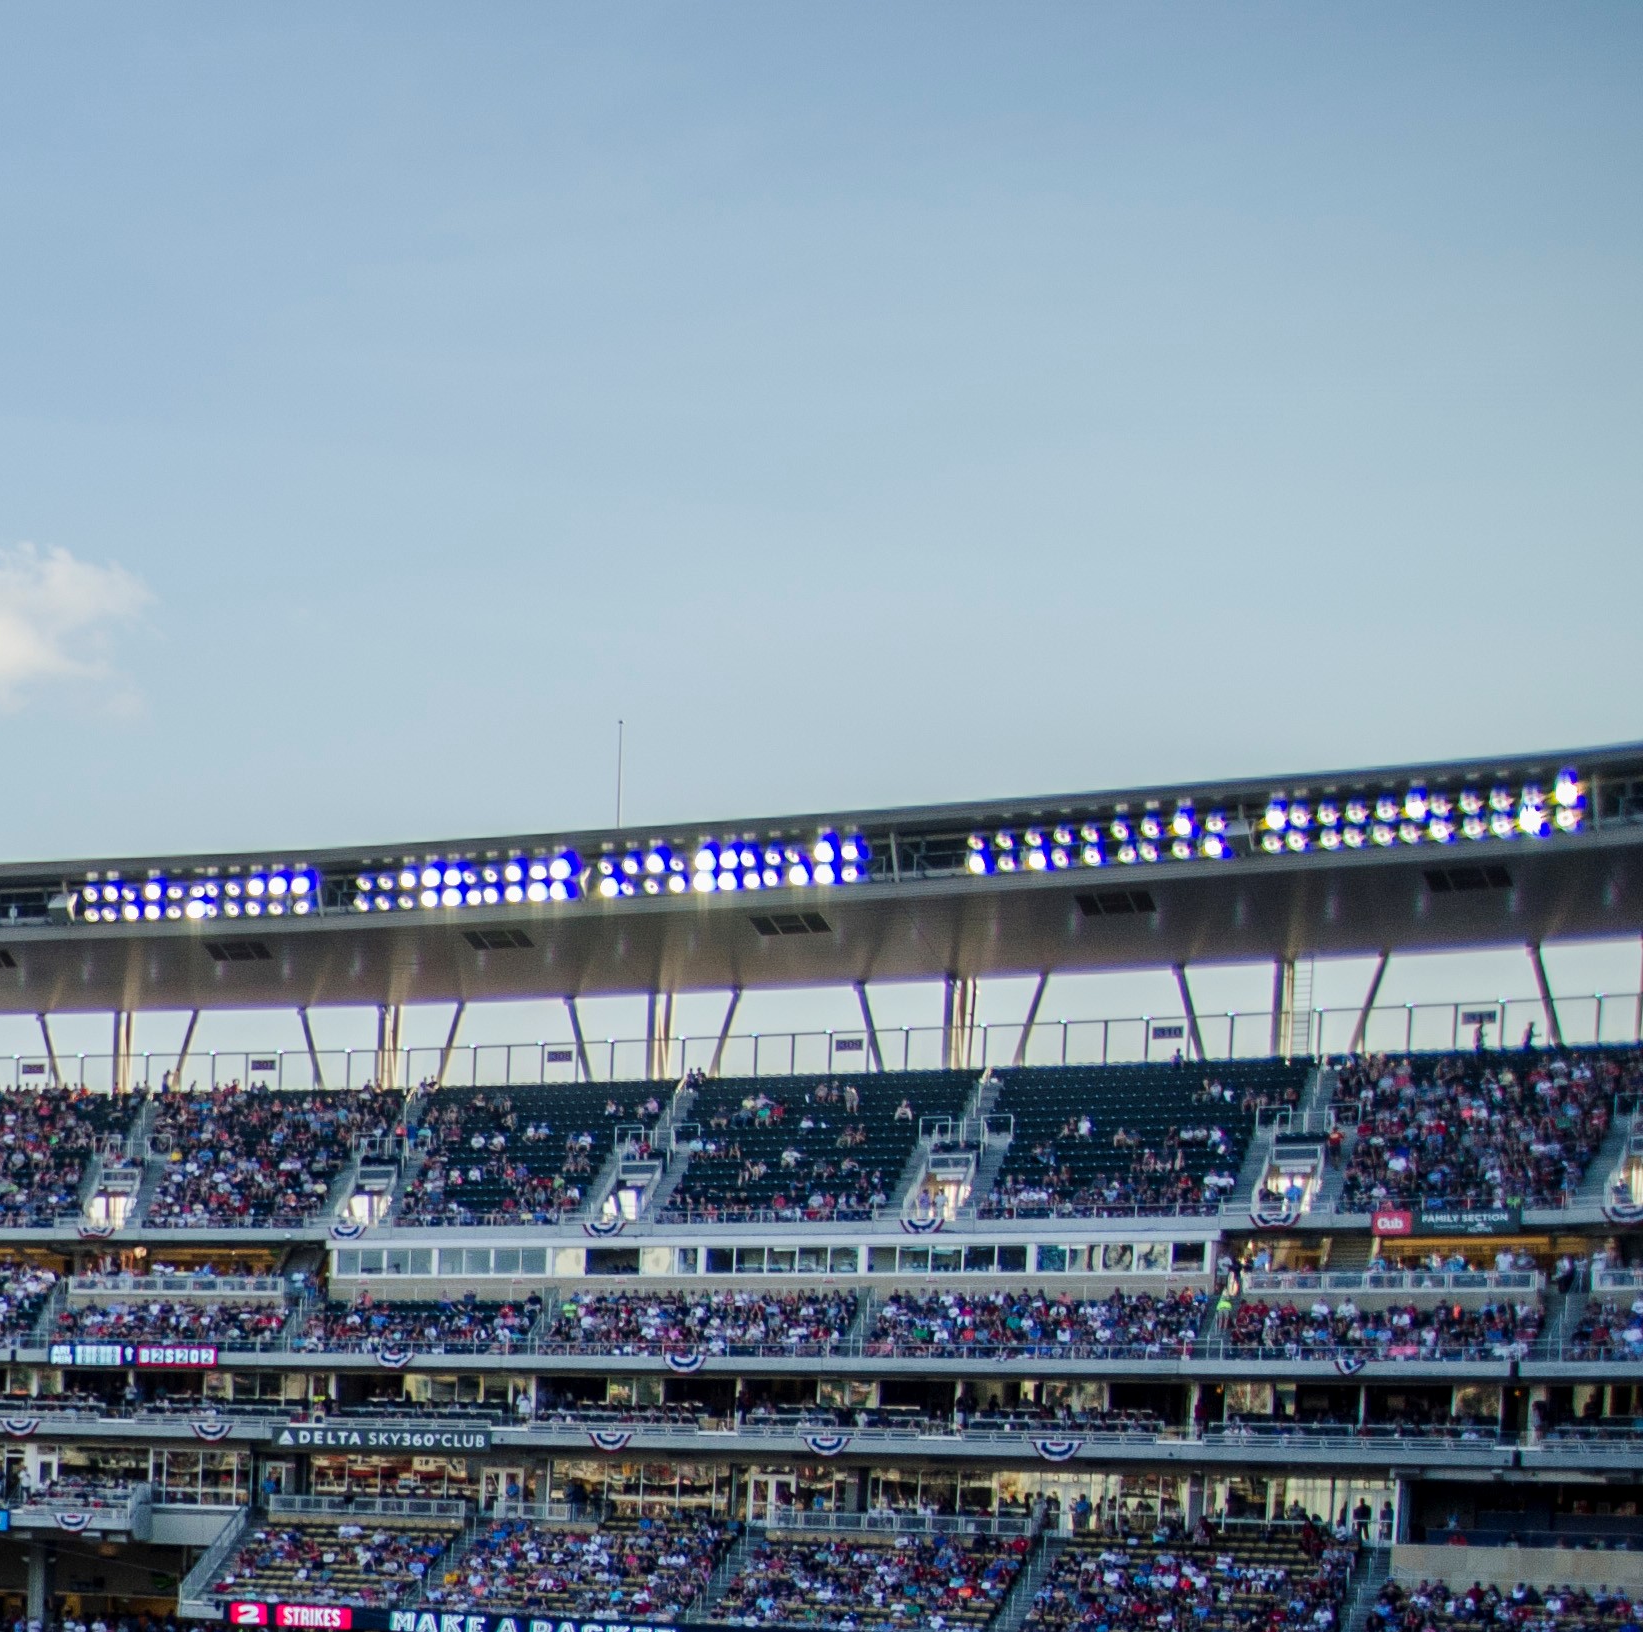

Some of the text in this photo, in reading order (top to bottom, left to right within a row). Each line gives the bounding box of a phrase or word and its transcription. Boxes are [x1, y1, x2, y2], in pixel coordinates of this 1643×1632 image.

[1377, 1217, 1403, 1230] Cub
[1421, 1213, 1509, 1224] FAMILY SECTION
[298, 1430, 362, 1446] DELTA
[237, 1605, 261, 1623] 2
[281, 1607, 342, 1628] STRIKES
